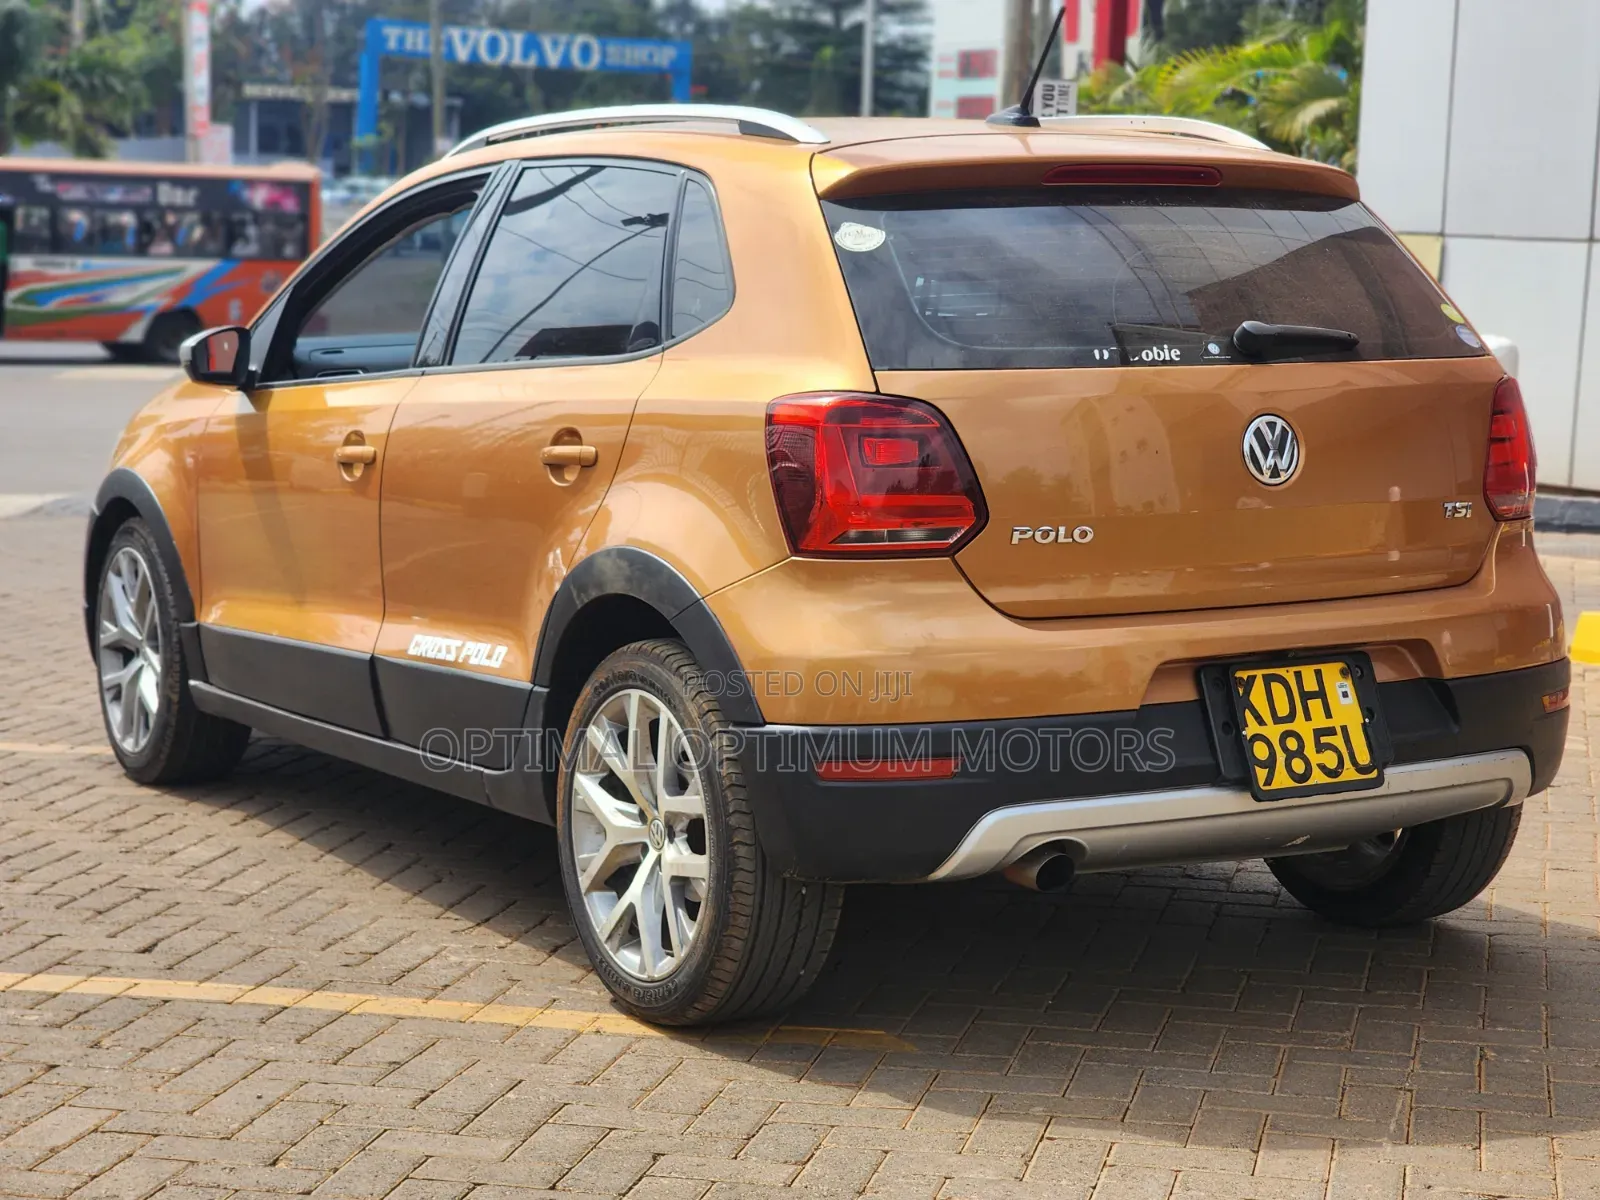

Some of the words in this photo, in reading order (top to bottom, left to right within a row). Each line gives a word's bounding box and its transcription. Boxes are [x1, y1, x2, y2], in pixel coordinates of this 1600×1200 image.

[446, 26, 600, 71] VOLVO
[604, 43, 677, 68] SHOP
[1041, 83, 1056, 110] YOU
[1010, 525, 1095, 545] POLO
[407, 633, 463, 662] CROSS
[457, 640, 509, 669] POLO
[1233, 668, 1334, 727] KDH
[1247, 723, 1379, 788] 985U
